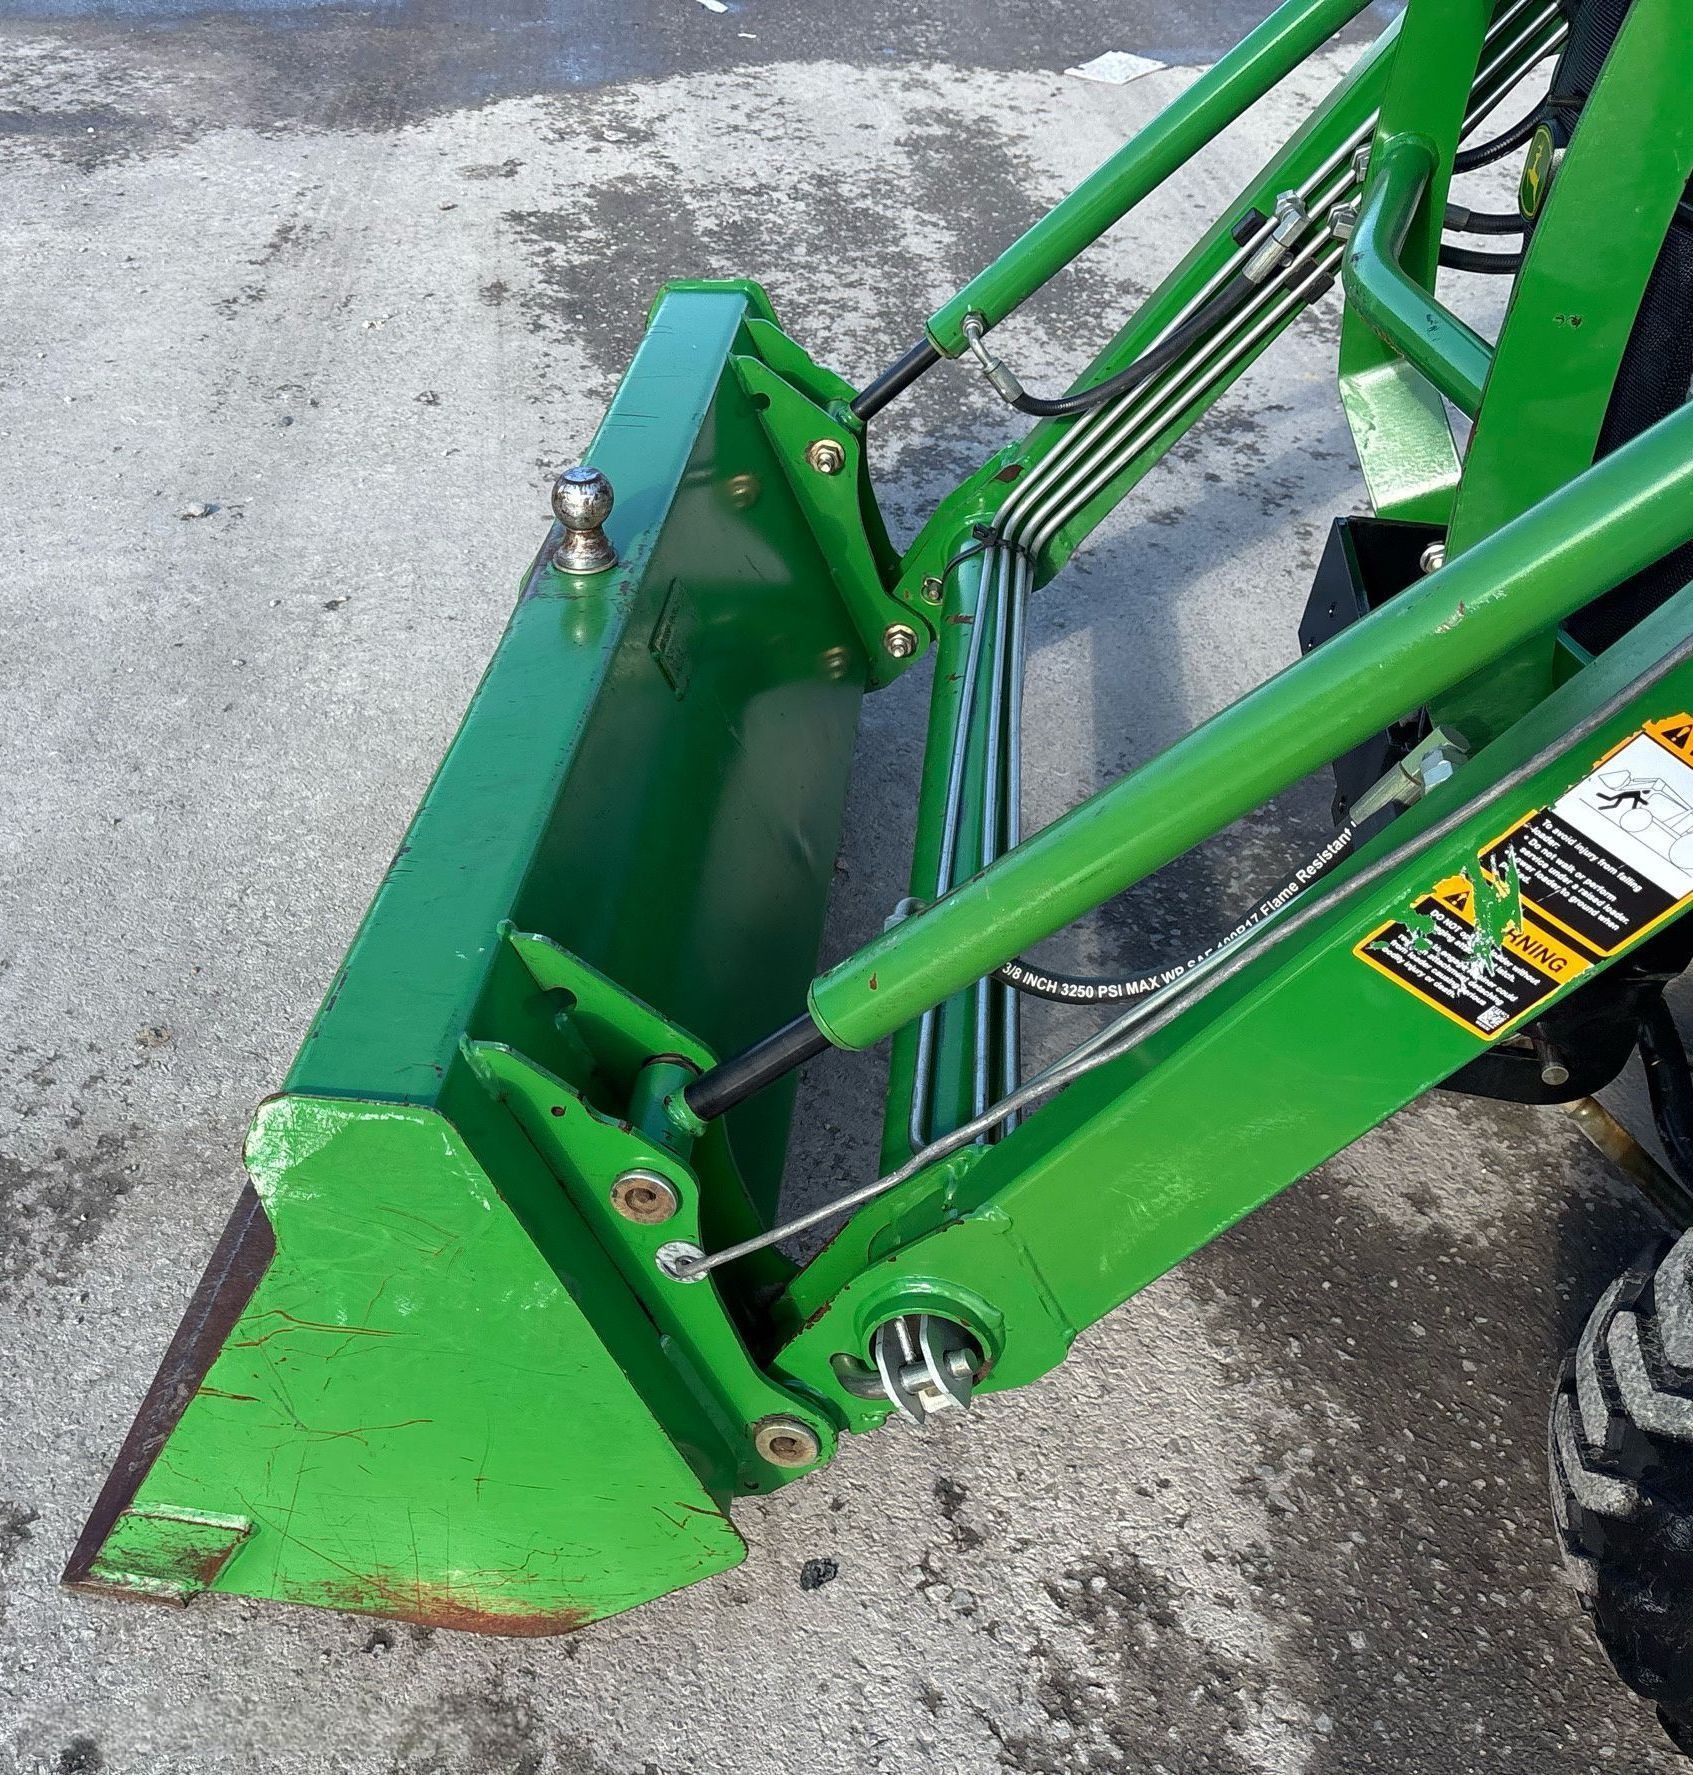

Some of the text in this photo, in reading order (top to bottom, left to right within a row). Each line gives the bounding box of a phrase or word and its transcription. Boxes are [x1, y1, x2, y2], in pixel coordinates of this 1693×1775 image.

[1519, 847, 1549, 869] service
[1548, 867, 1573, 885] under
[1578, 888, 1606, 907] raised
[1528, 838, 1617, 902] Do not walk or perform
[1542, 819, 1642, 893] To avoid injury from falling
[1001, 961, 1023, 980] 3/8
[1022, 970, 1058, 994] INCH
[1060, 982, 1095, 999] 3250
[1097, 978, 1123, 998] PSI
[1126, 975, 1161, 996] MAX
[1260, 881, 1300, 917] Flame
[1296, 827, 1353, 884] Resistant
[1534, 870, 1561, 891] loader
[1560, 887, 1570, 897] to
[1568, 896, 1600, 916] ground
[1597, 914, 1619, 931] when
[1389, 940, 1412, 954] from
[1407, 951, 1432, 969] loader
[1431, 968, 1463, 989] causing
[1404, 961, 1426, 977] injury
[1430, 909, 1445, 921] DO
[1443, 918, 1463, 932] NOT
[1512, 965, 1541, 985] without
[1506, 926, 1569, 974] RNING
[1465, 980, 1504, 1006] detaching
[1495, 987, 1518, 1002] could
